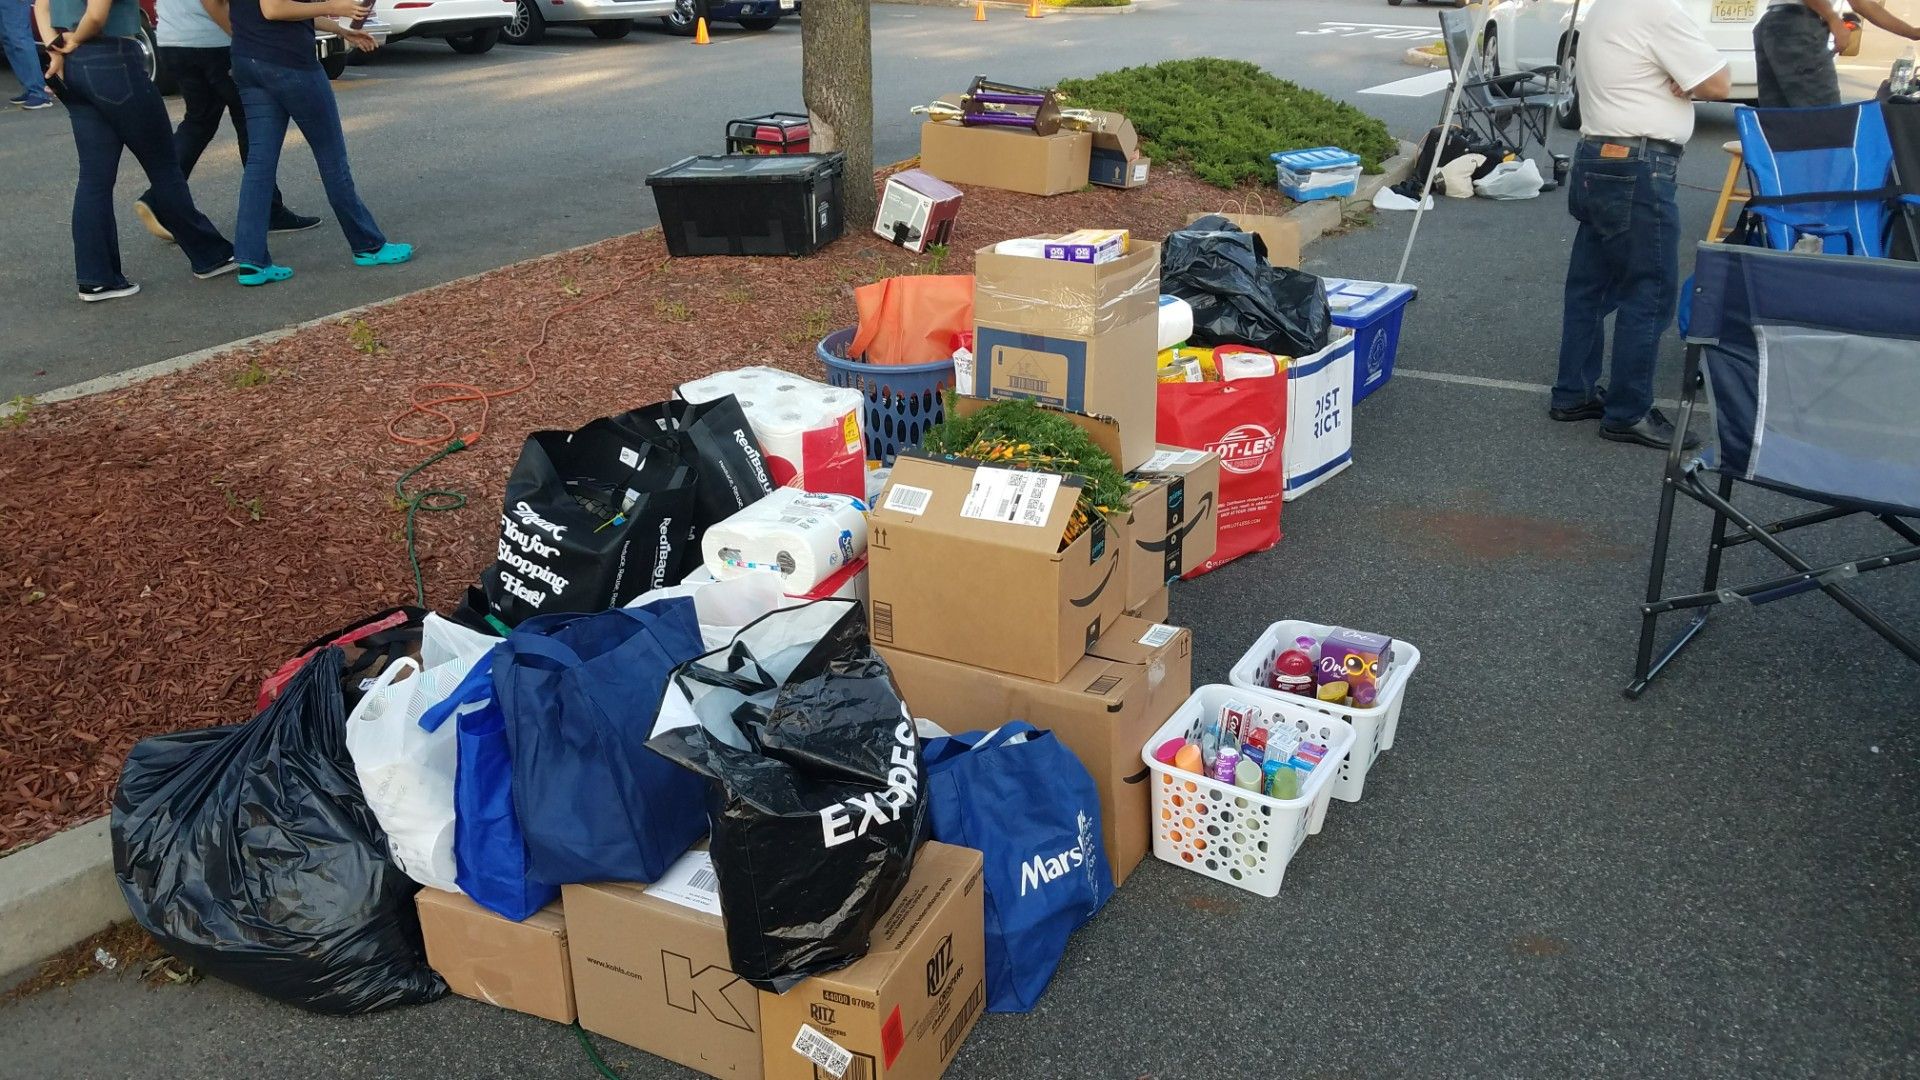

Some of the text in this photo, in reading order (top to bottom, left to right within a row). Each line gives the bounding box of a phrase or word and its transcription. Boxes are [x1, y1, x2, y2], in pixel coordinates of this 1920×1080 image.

[1206, 436, 1276, 460] LOT-LESS
[501, 513, 561, 558] You for
[512, 501, 568, 541] Thank
[497, 538, 570, 595] Shopping
[500, 571, 546, 609] Here!
[1320, 656, 1351, 674] One
[586, 955, 643, 982] www.kohls.com
[926, 932, 954, 998] RITZ
[661, 949, 755, 1033] K
[851, 998, 876, 1010] 07092
[810, 1003, 836, 1024] RITZ
